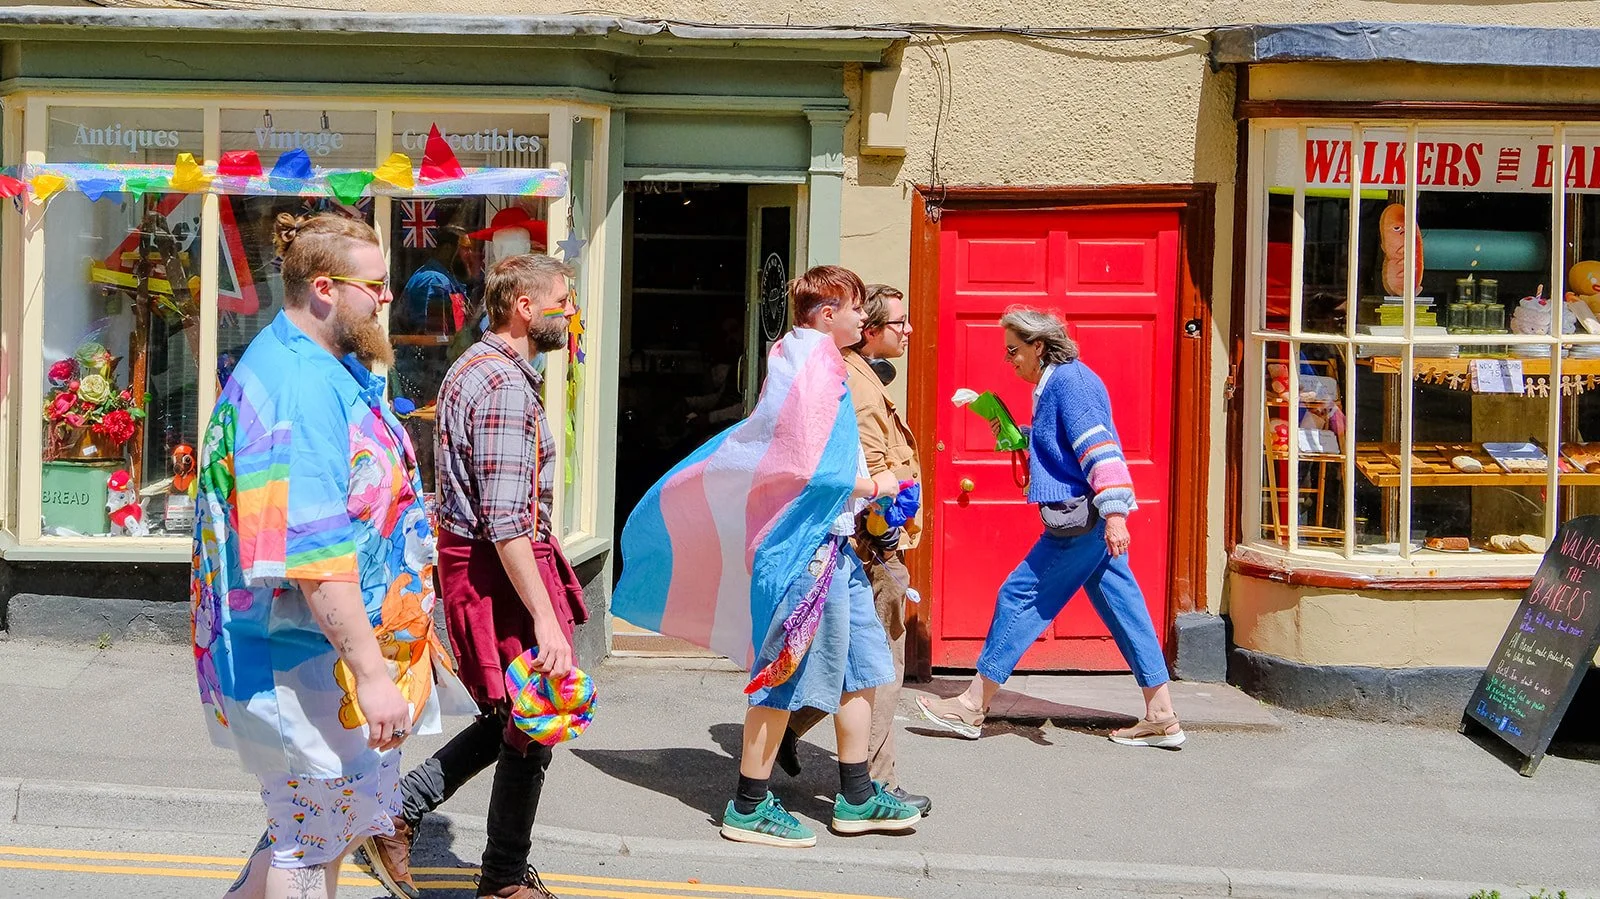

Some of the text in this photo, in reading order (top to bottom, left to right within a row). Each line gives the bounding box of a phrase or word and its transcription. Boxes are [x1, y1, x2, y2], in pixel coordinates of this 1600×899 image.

[73, 124, 540, 156] Antiques Vintage Colectibles
[1305, 140, 1483, 187] WALKERS
[1496, 147, 1521, 184] THE
[42, 490, 90, 505] BREAD
[1566, 566, 1586, 584] THE
[1529, 577, 1592, 621] BAKERS
[325, 772, 364, 790] LOVE
[292, 793, 324, 817] LOVE
[294, 829, 328, 850] LOVE
